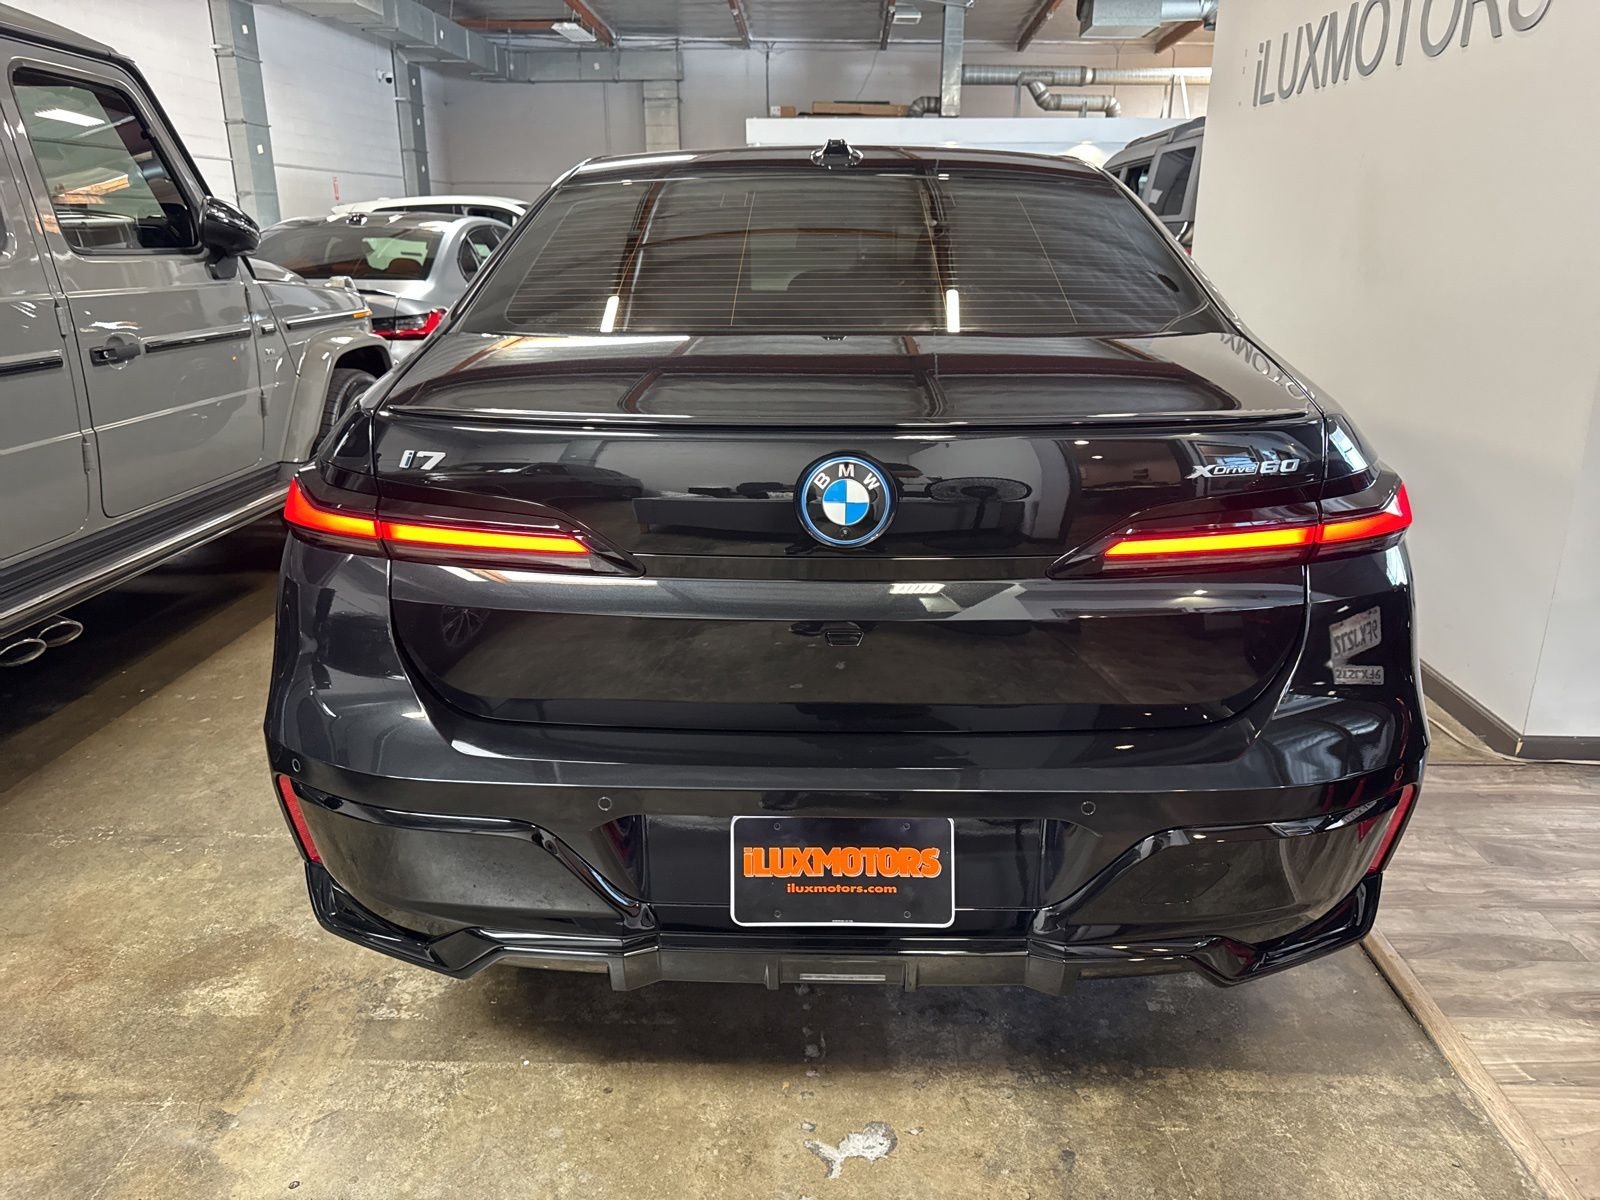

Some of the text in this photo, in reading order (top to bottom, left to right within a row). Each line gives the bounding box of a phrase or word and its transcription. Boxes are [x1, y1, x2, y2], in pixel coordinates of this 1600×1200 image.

[399, 449, 447, 471] i7
[813, 463, 880, 490] BMW
[743, 847, 942, 878] iLUXMOTORS
[786, 883, 897, 893] iluxmotors.com
